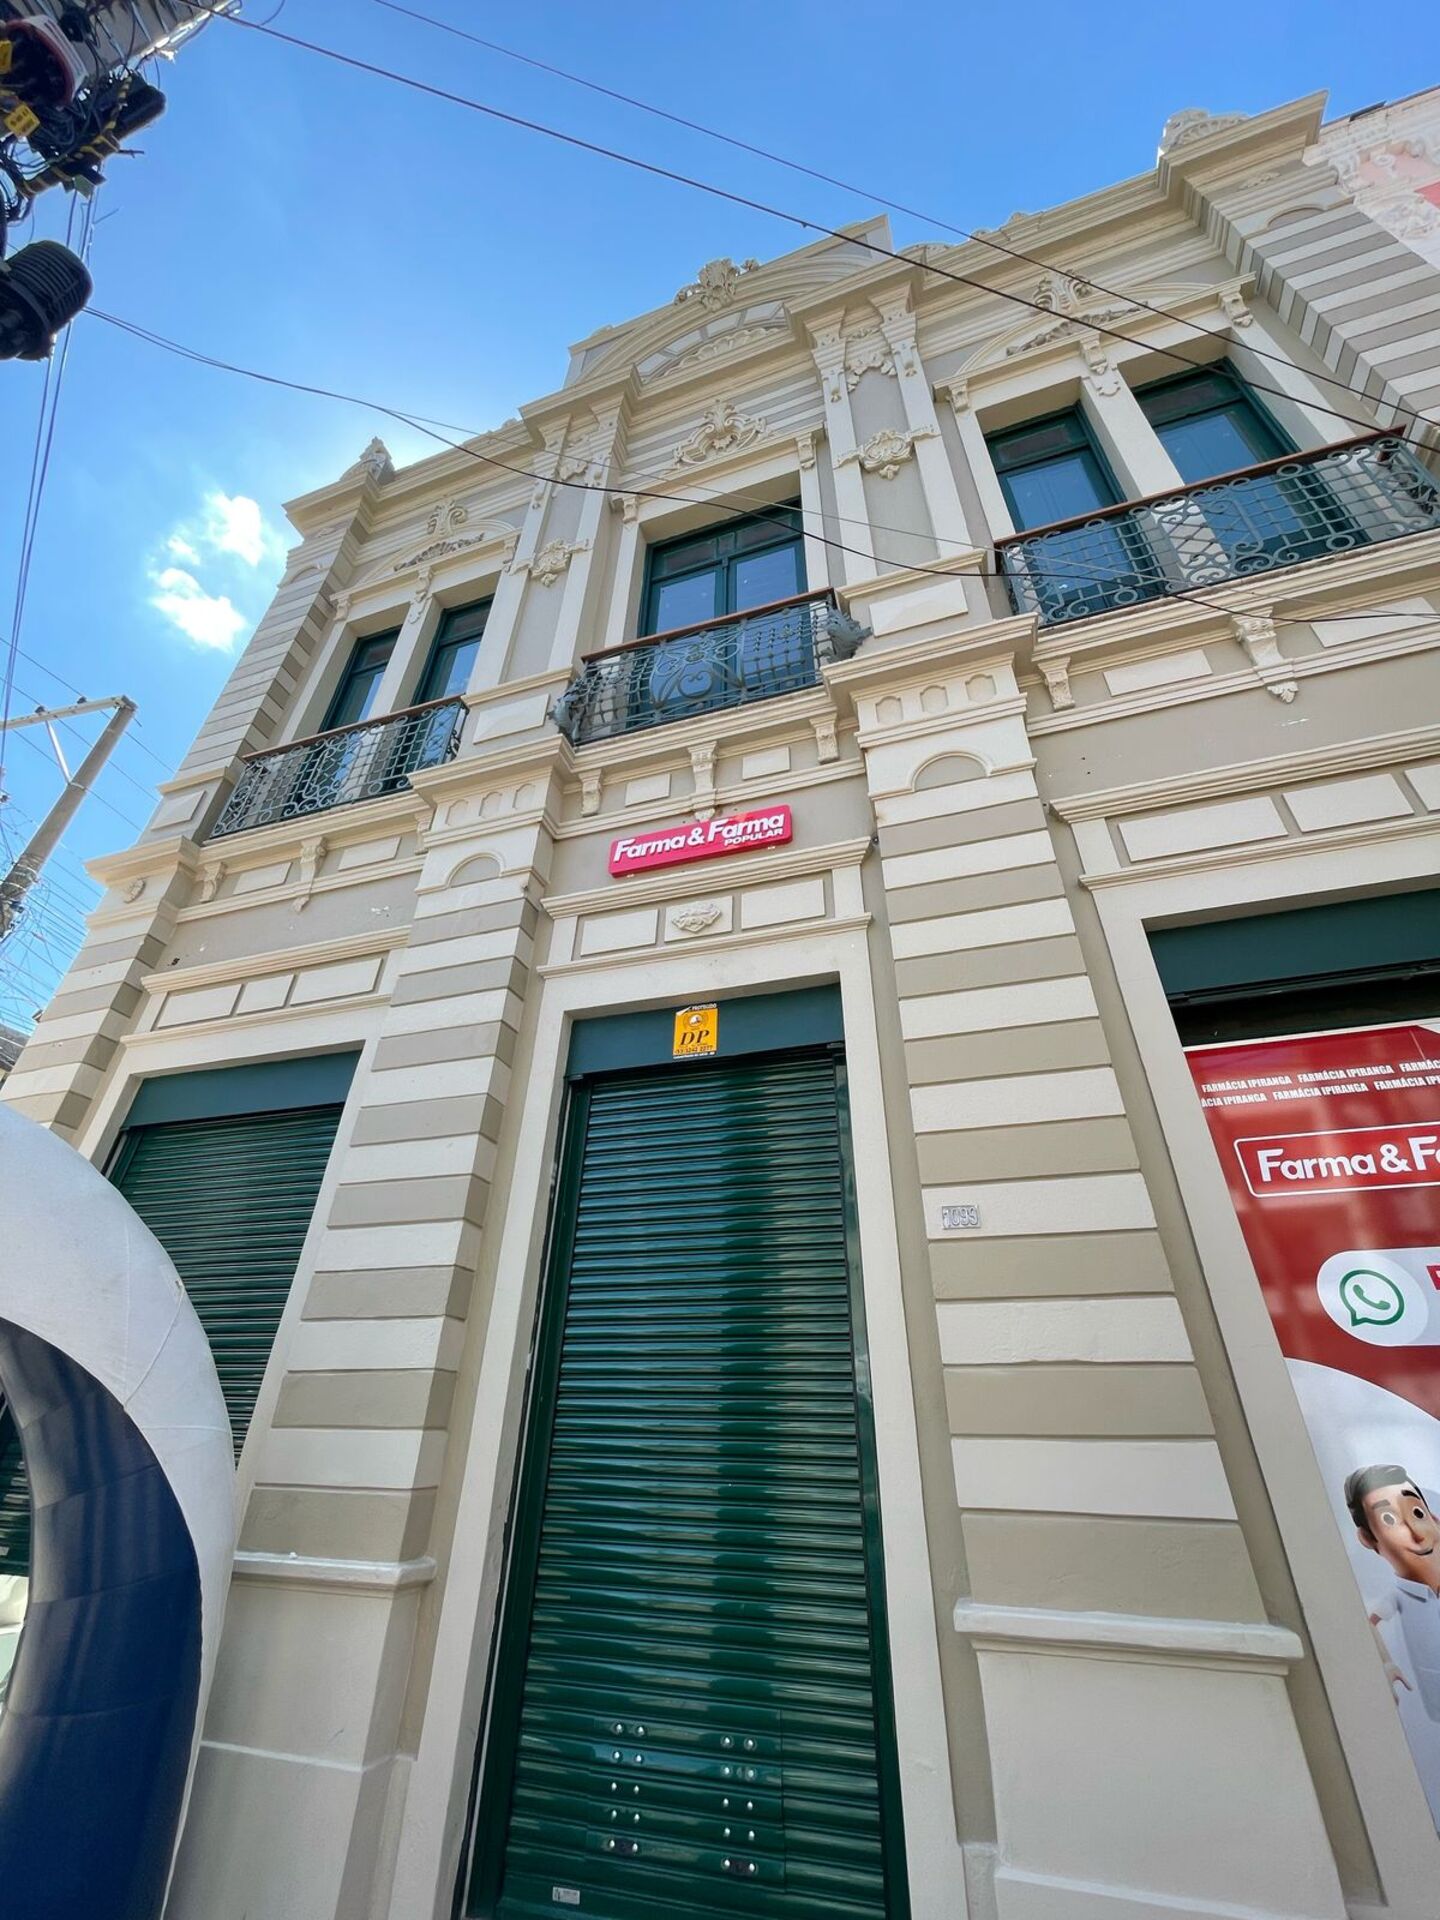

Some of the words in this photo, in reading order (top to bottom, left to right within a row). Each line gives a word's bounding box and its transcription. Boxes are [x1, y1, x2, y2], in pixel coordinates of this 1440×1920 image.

[613, 834, 686, 862] Farma
[687, 827, 705, 847] &
[707, 813, 786, 842] Farma
[724, 828, 784, 847] POPULAR
[680, 1029, 710, 1046] DP
[1201, 1080, 1248, 1093] FARMÁCIA
[1247, 1075, 1292, 1088] IPIRANGA
[1297, 1069, 1347, 1083] FARMÁCIA
[1346, 1065, 1394, 1078] IPIRANGA
[1223, 1093, 1268, 1105] IPIRANGA
[1273, 1087, 1322, 1101] FARMÁCIA
[1321, 1083, 1369, 1096] IPIRANGA
[1374, 1077, 1427, 1091] FARMÁCIA
[1257, 1148, 1377, 1182] Farma
[1380, 1143, 1412, 1173] &
[1408, 1136, 1440, 1170] F
